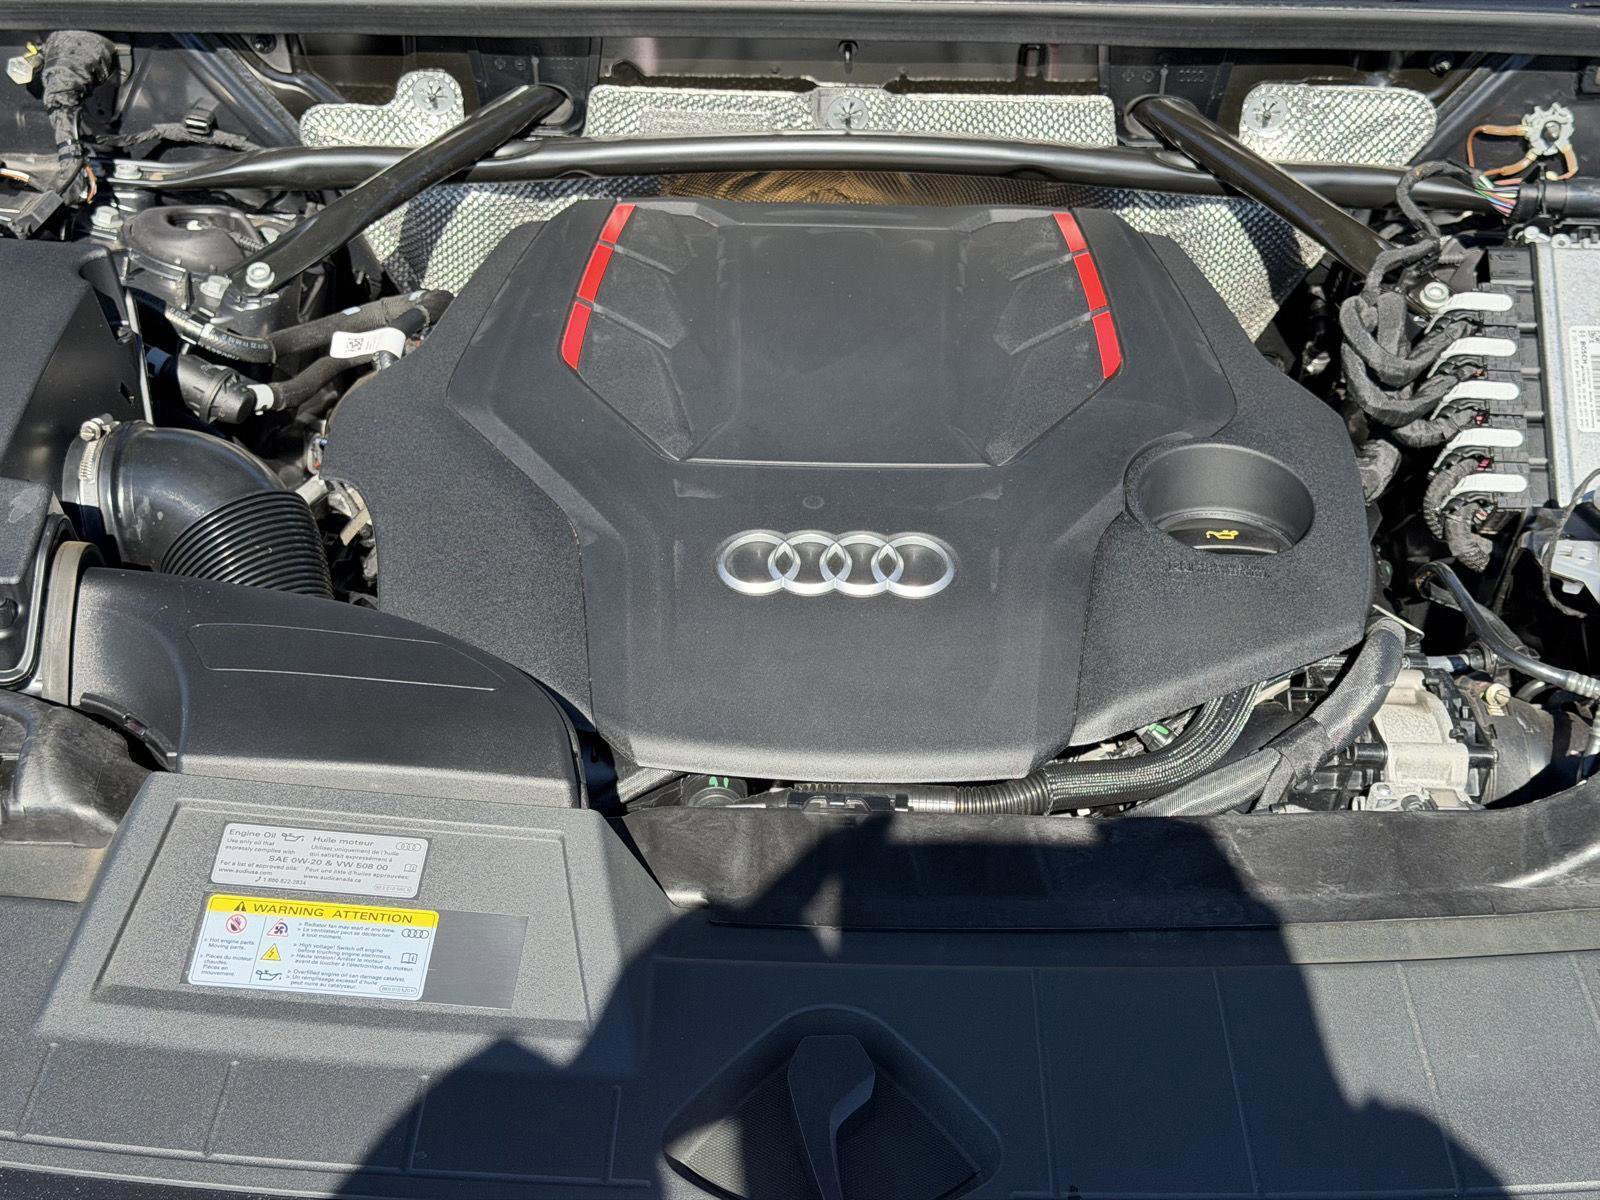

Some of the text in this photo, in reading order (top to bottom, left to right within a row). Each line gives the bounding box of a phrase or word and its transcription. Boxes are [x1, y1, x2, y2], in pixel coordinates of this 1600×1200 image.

[229, 829, 260, 838] Engine
[254, 904, 413, 923] WARNING ATTENTION
